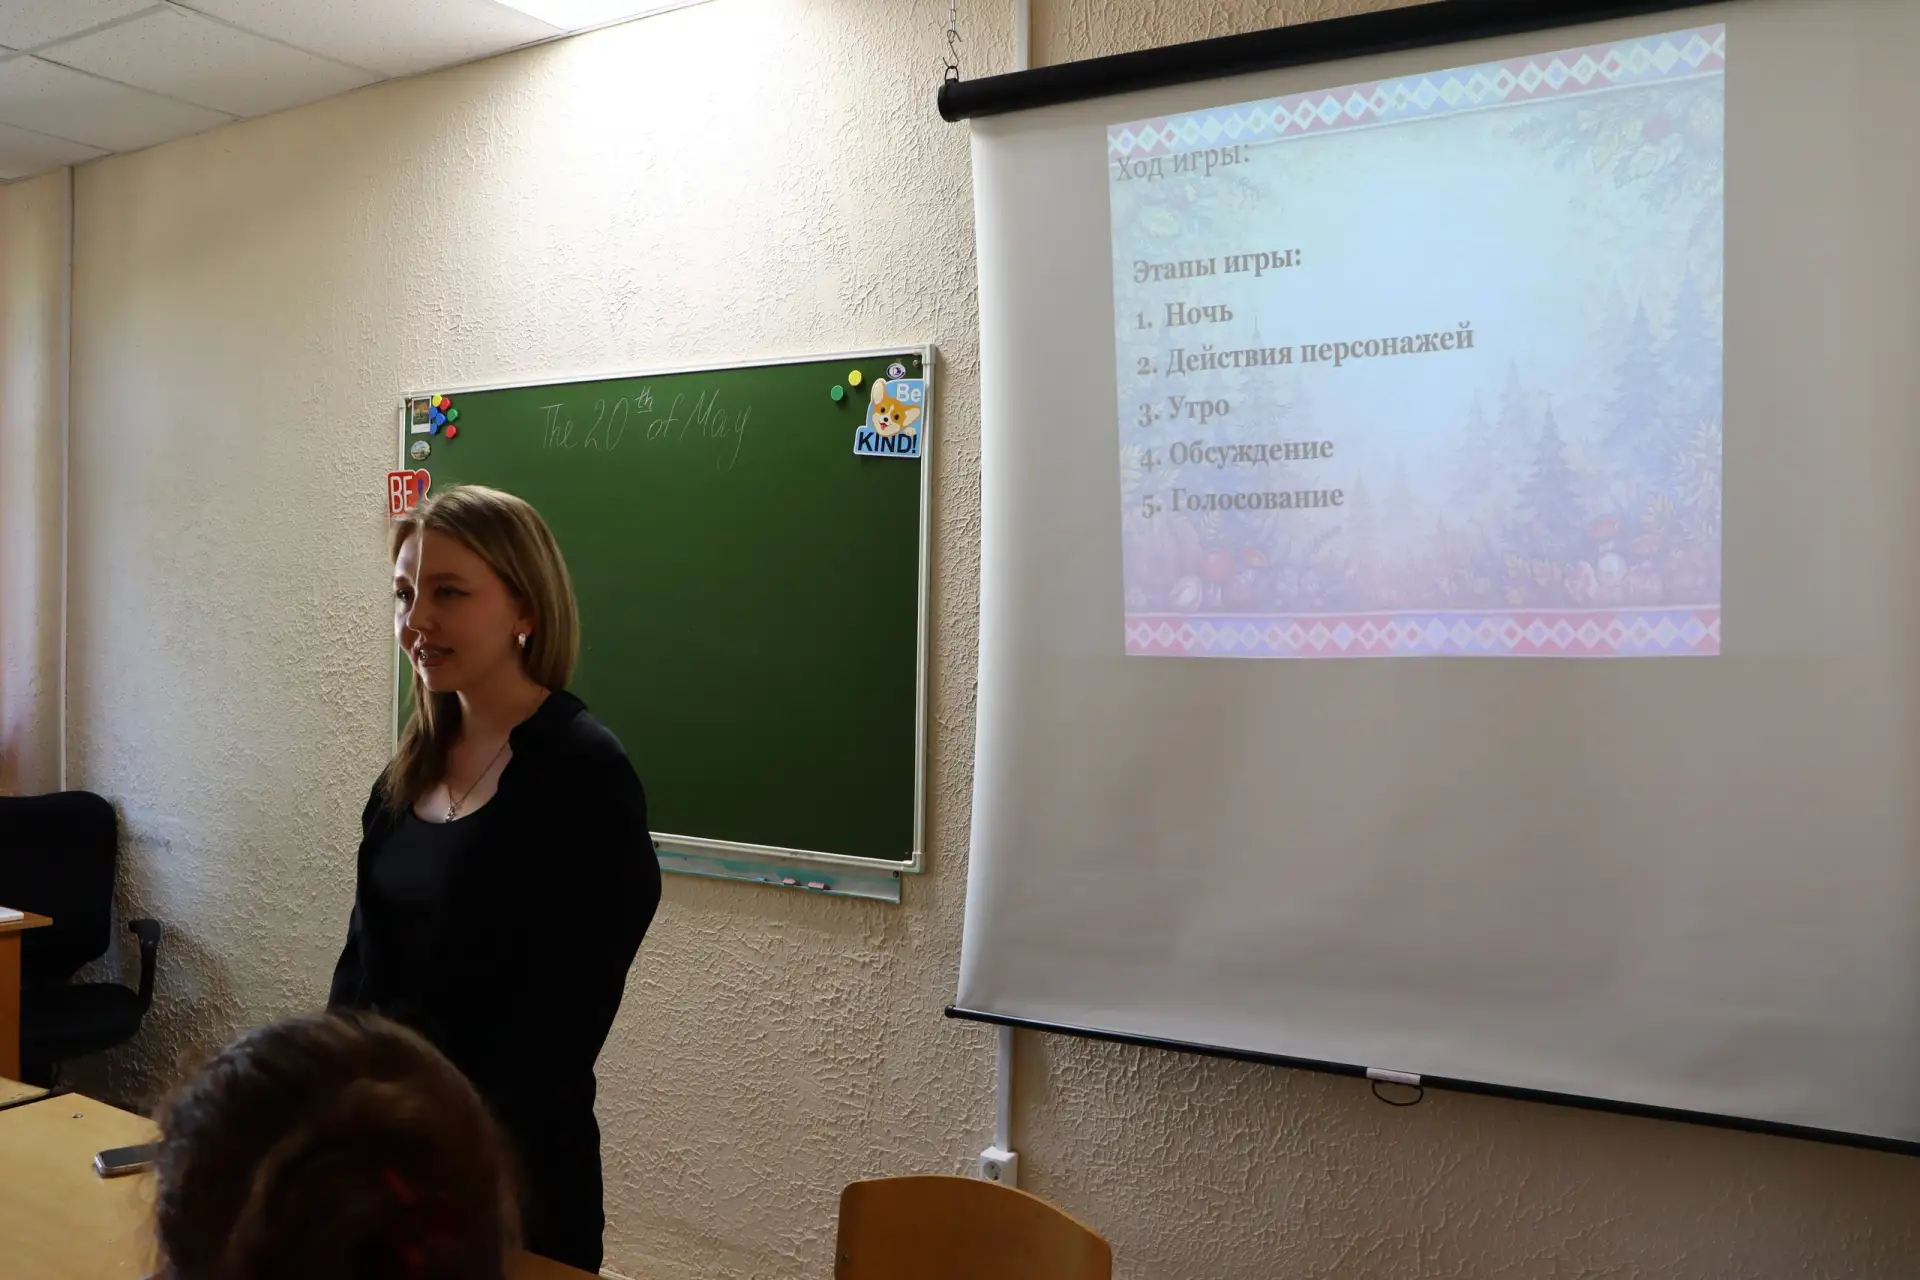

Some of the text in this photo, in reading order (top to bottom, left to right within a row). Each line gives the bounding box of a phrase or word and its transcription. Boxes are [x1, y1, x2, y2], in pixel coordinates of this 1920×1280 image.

[1116, 144, 1250, 182] Ход игры:
[1133, 248, 1302, 283] Этапы игры:
[1135, 302, 1234, 329] 1. Ночь
[1136, 321, 1475, 377] 2. Действия персонажей
[896, 383, 921, 402] Be
[1138, 396, 1230, 427] 3. Утро
[540, 403, 575, 449] The
[647, 393, 684, 441] of
[681, 388, 752, 472] May
[857, 431, 917, 454] KIND!
[1140, 439, 1335, 472] 4. Обсуждение
[1142, 488, 1345, 518] 5. Голосование
